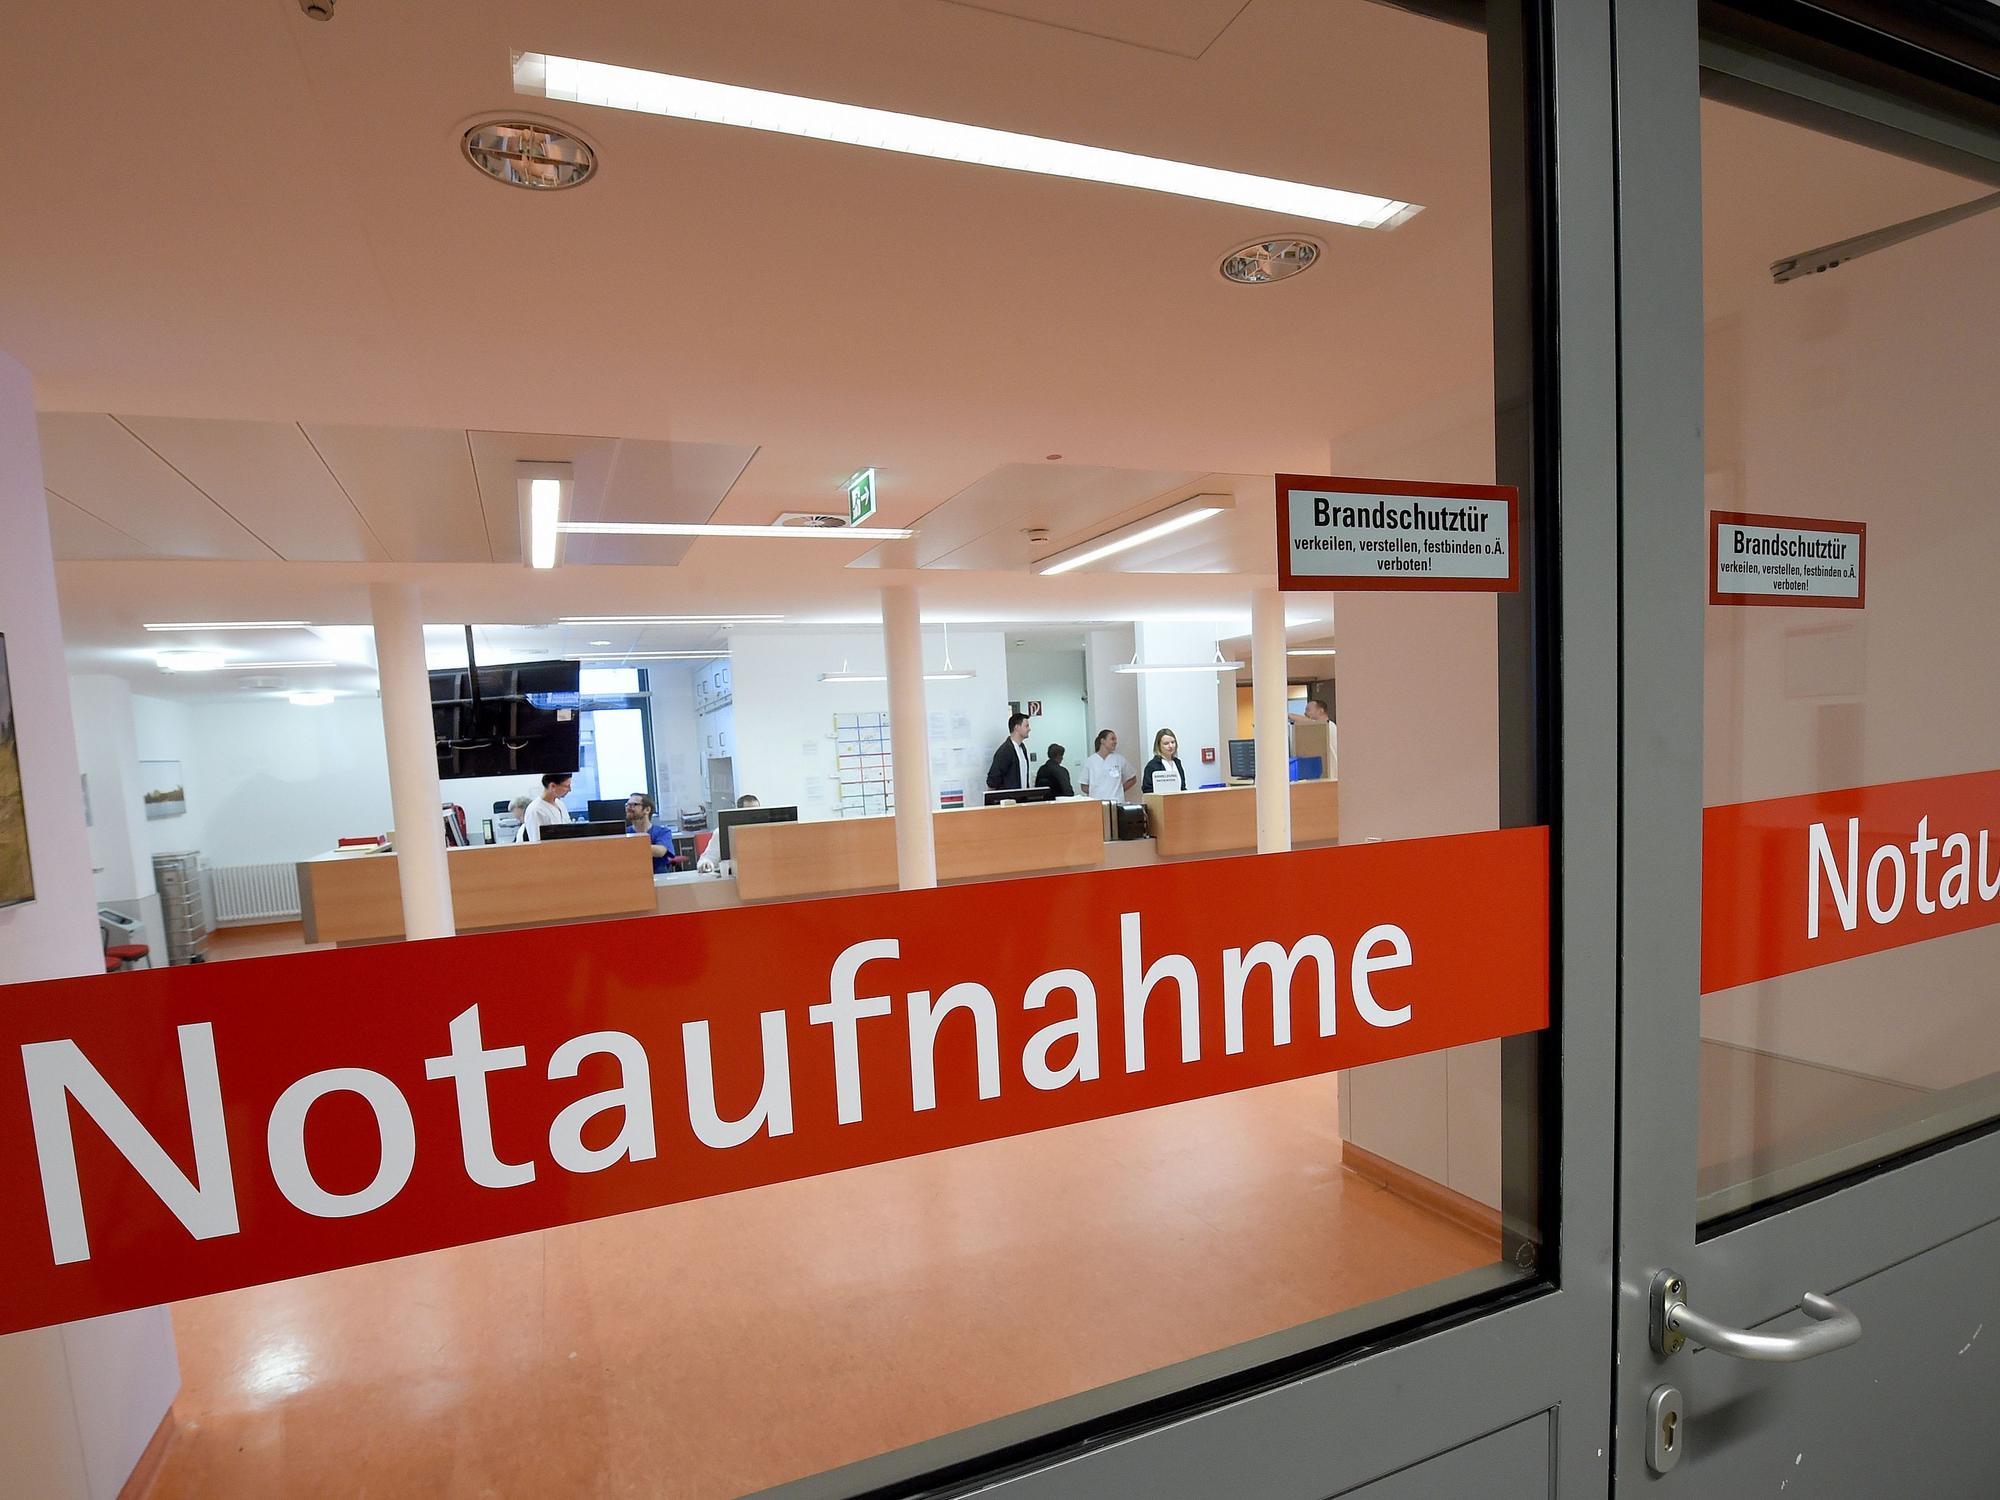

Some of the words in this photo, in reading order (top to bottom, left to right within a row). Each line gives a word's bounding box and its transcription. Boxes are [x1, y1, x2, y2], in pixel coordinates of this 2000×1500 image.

[1313, 497, 1488, 532] Brandschutztür
[1294, 535, 1356, 552] verkeilen,
[1359, 537, 1421, 554] verstellen,
[1423, 538, 1482, 554] festbinden
[1484, 537, 1505, 555] o.Ä.
[1734, 530, 1847, 560] Brandschutztür
[1377, 556, 1432, 571] verboten!
[1720, 560, 1761, 575] verkeilen,
[1762, 563, 1802, 577] verstellen,
[1803, 564, 1842, 578] festbinden
[1773, 578, 1809, 591] verboten!
[20, 911, 1413, 1266] Notaufnahme
